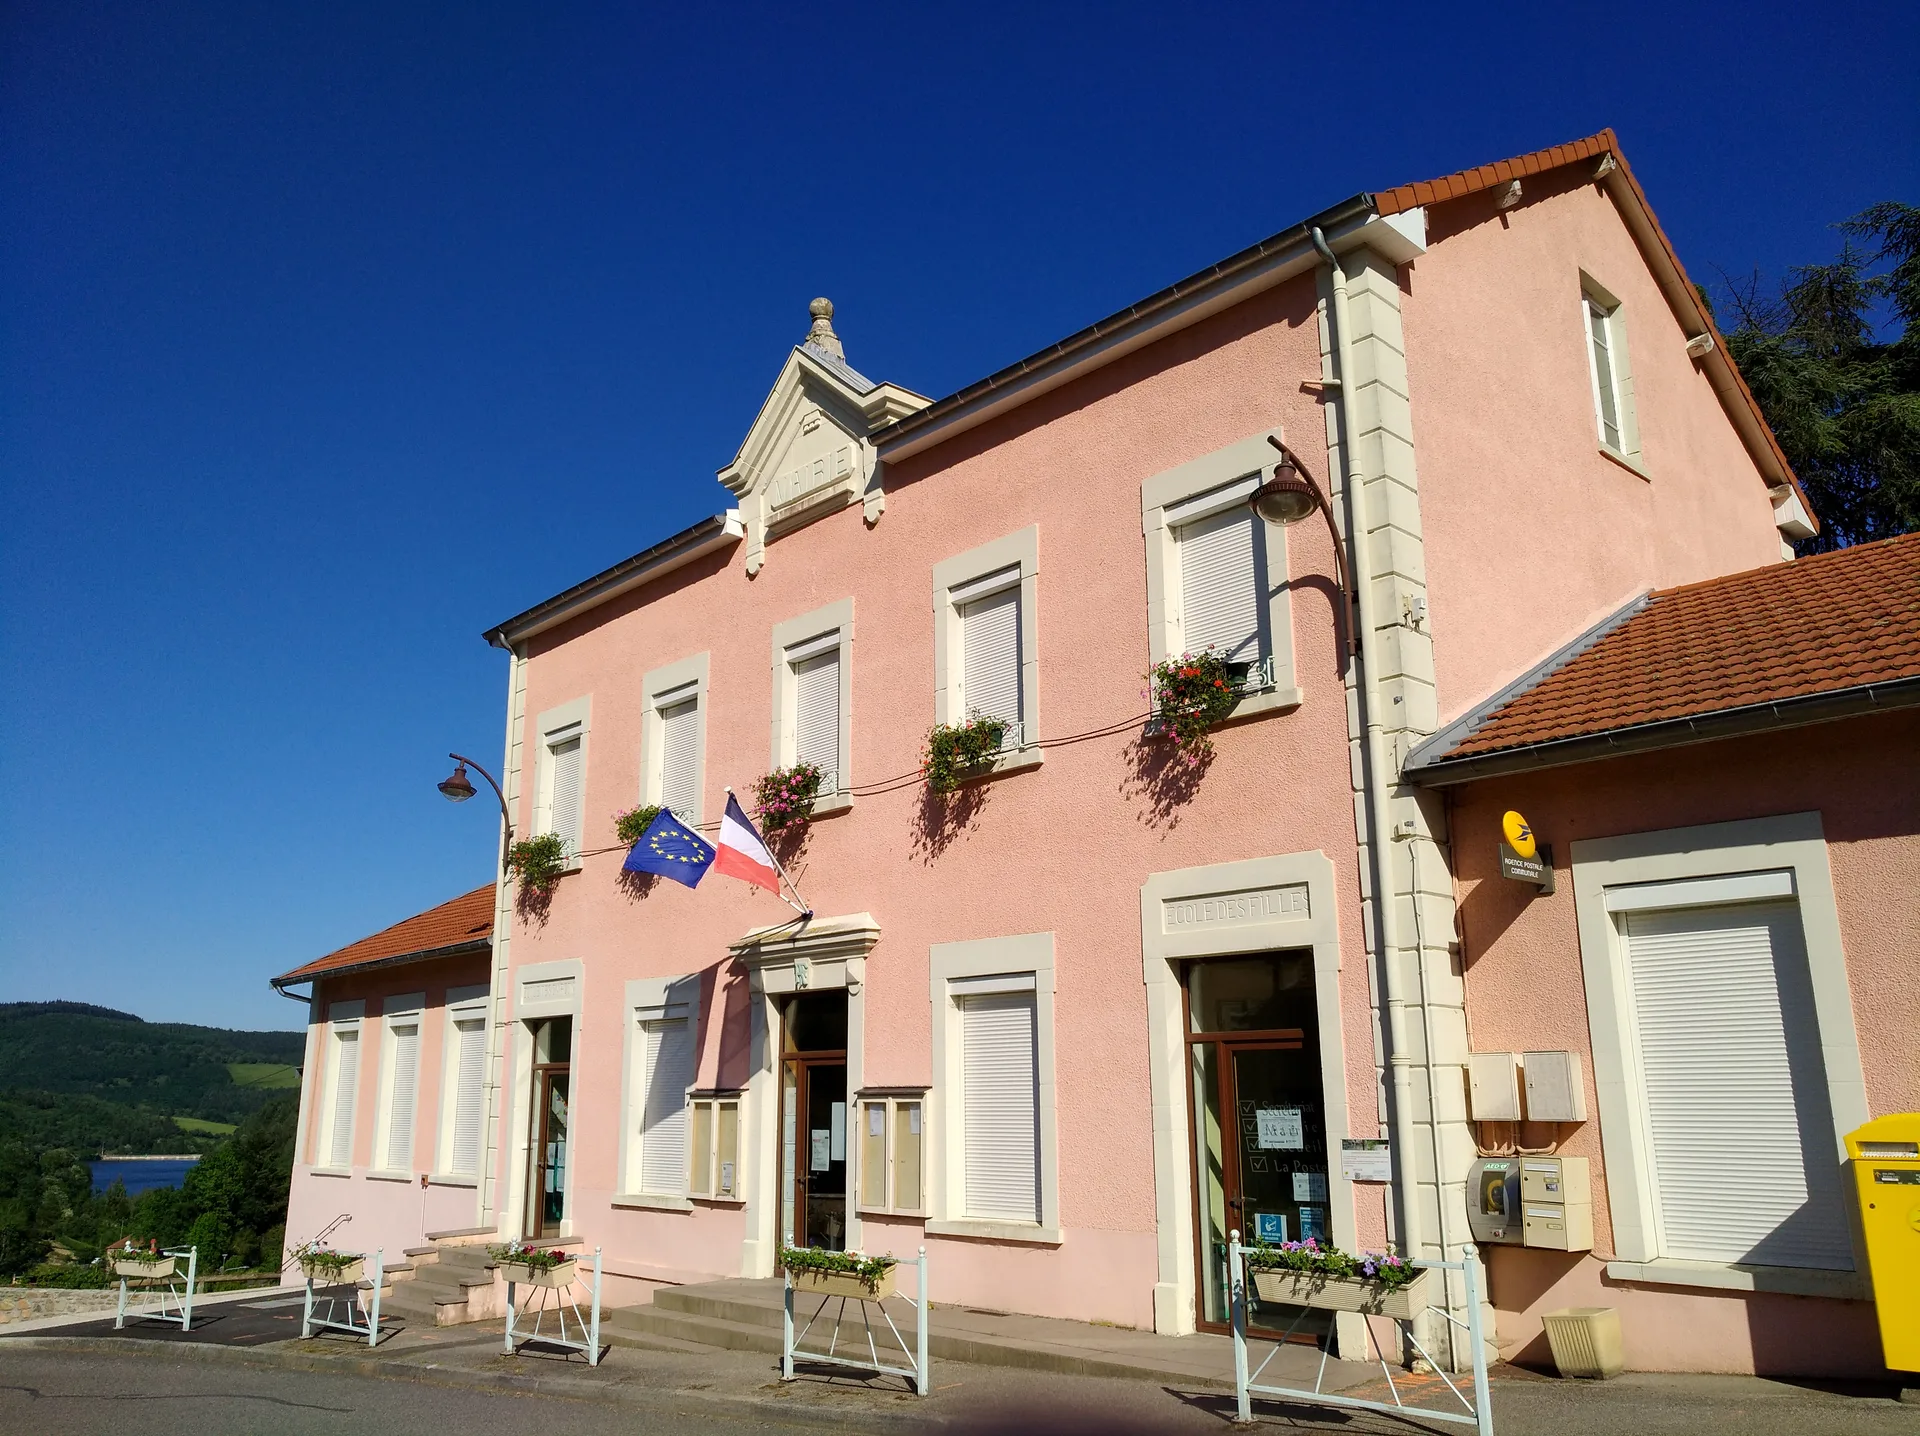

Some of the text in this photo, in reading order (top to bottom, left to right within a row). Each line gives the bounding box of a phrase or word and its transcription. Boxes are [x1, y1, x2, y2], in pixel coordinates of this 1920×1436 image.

[1504, 857, 1543, 871] AGENCE POSTALE
[1511, 867, 1539, 878] COMMUNALE
[1216, 898, 1246, 920] DES
[1274, 1160, 1289, 1173] La
[1293, 1159, 1327, 1173] Poste
